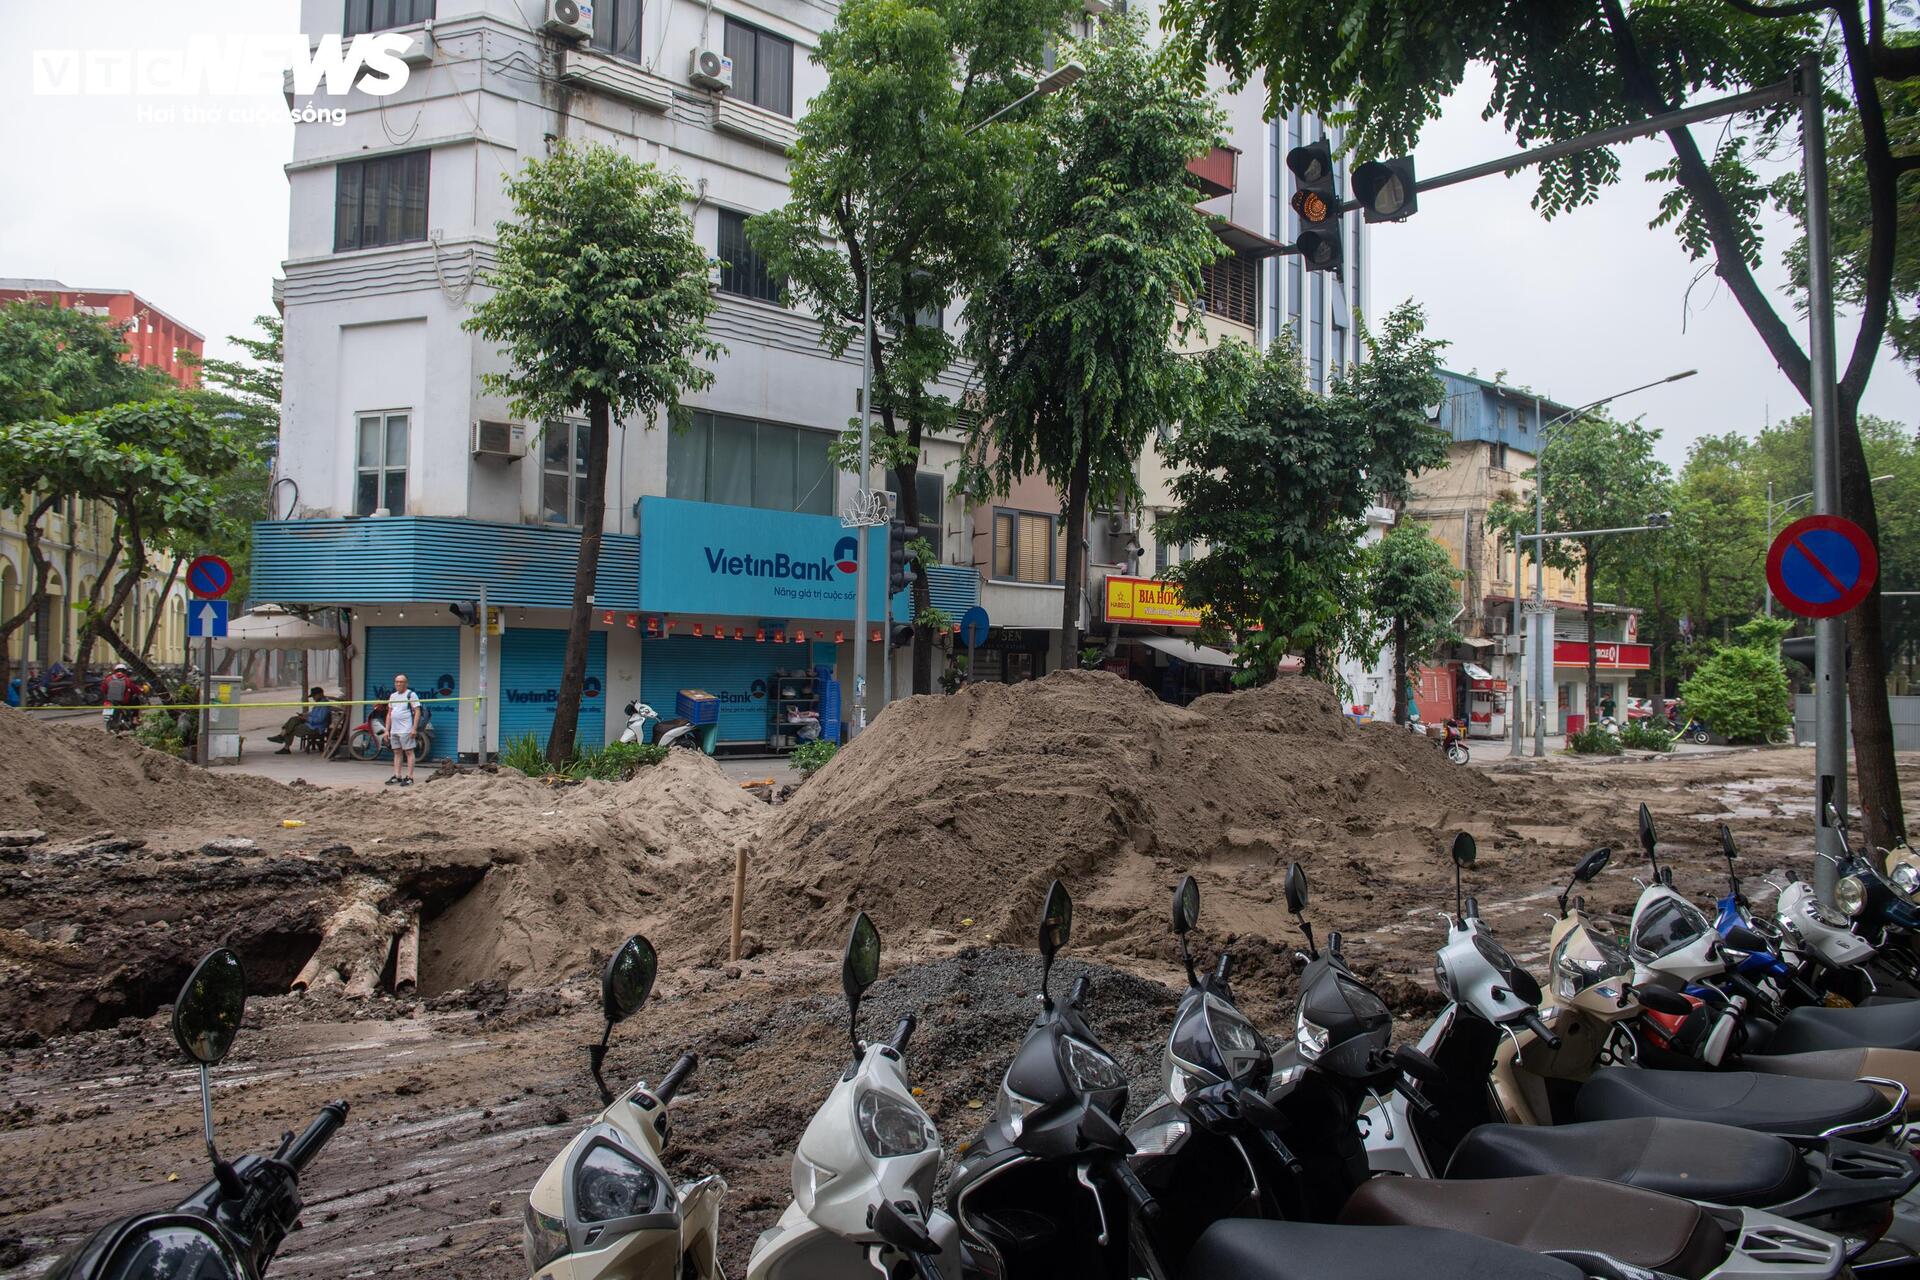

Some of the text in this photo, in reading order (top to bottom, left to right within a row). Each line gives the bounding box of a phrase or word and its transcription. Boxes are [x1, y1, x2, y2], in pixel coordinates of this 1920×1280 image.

[703, 546, 835, 582] VietinBank
[774, 587, 797, 599] Nâng
[1138, 589, 1155, 605] BIA
